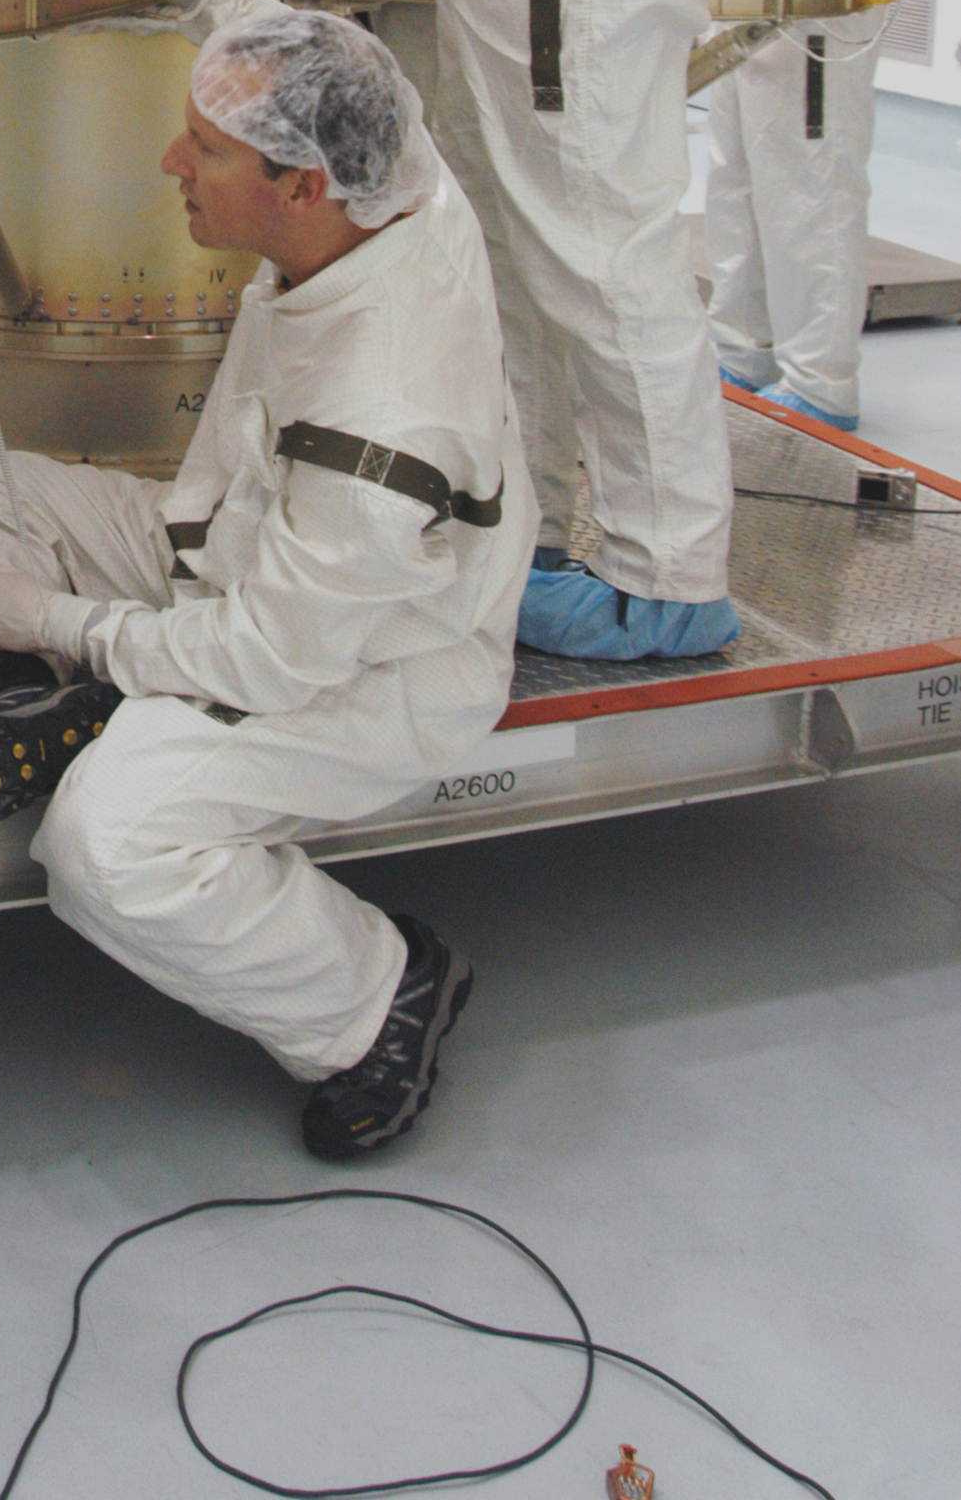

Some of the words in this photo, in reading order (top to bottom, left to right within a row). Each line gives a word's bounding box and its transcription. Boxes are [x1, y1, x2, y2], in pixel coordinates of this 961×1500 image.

[209, 268, 227, 284] IV
[919, 674, 961, 700] HOI
[917, 701, 952, 726] TIE
[433, 770, 515, 803] A2600
